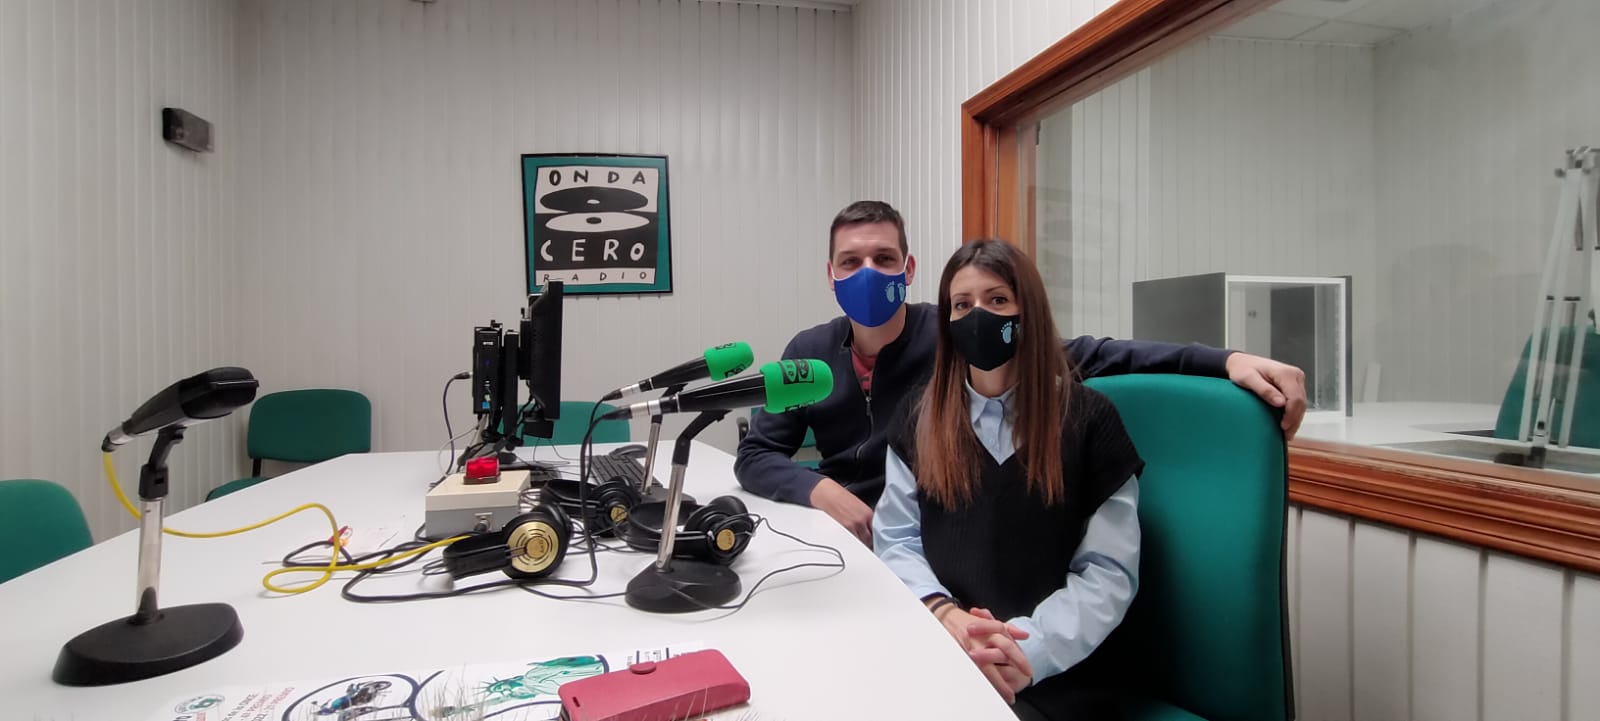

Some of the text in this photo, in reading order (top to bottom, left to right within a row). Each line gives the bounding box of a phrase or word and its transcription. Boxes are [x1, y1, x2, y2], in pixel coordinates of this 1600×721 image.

[550, 170, 646, 186] ONDA
[541, 239, 645, 261] CERO
[543, 272, 647, 281] RADIO
